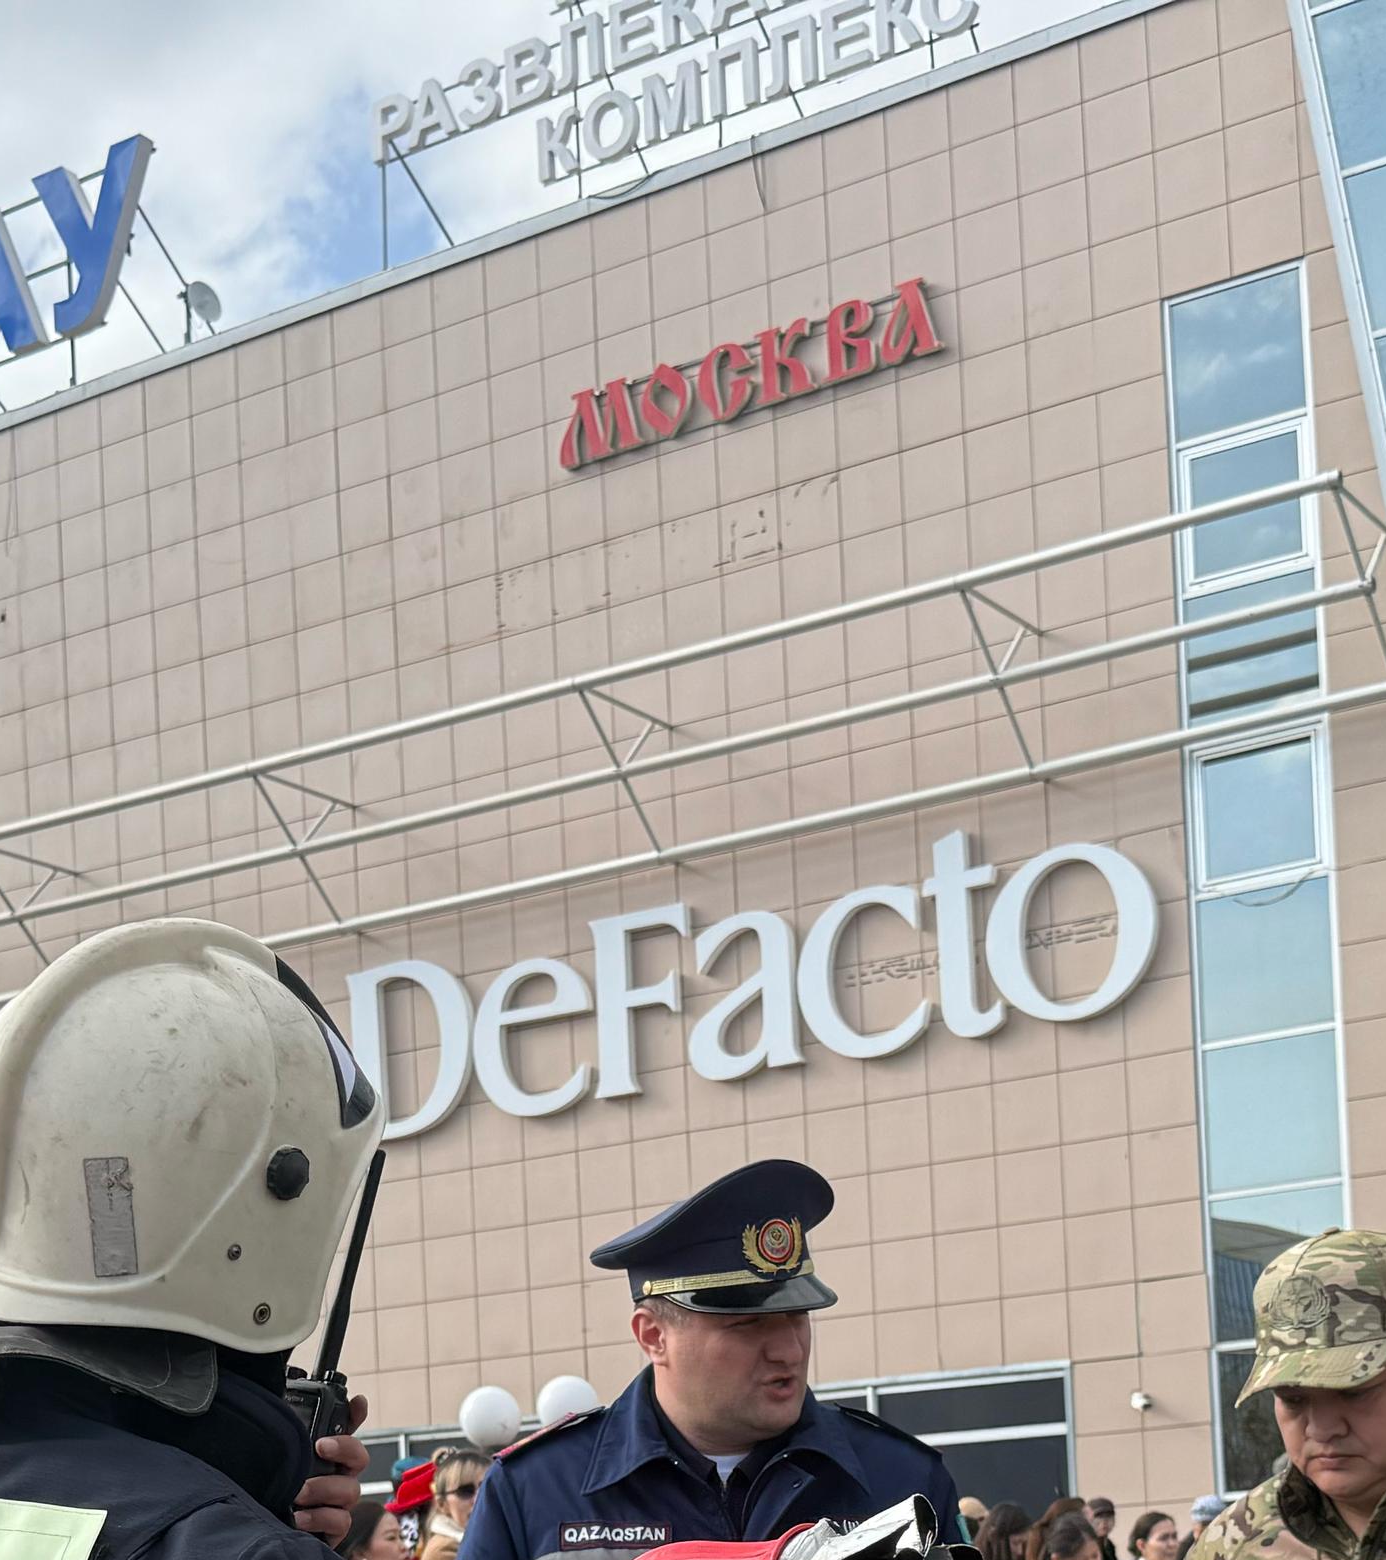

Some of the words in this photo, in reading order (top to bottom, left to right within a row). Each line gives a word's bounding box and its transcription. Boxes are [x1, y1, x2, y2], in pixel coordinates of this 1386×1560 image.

[535, 0, 979, 185] КОМПЛЕКС
[559, 277, 946, 470] МОСКВА
[346, 829, 1159, 1142] DeFacto
[564, 1526, 666, 1542] QAZAQSTAN
